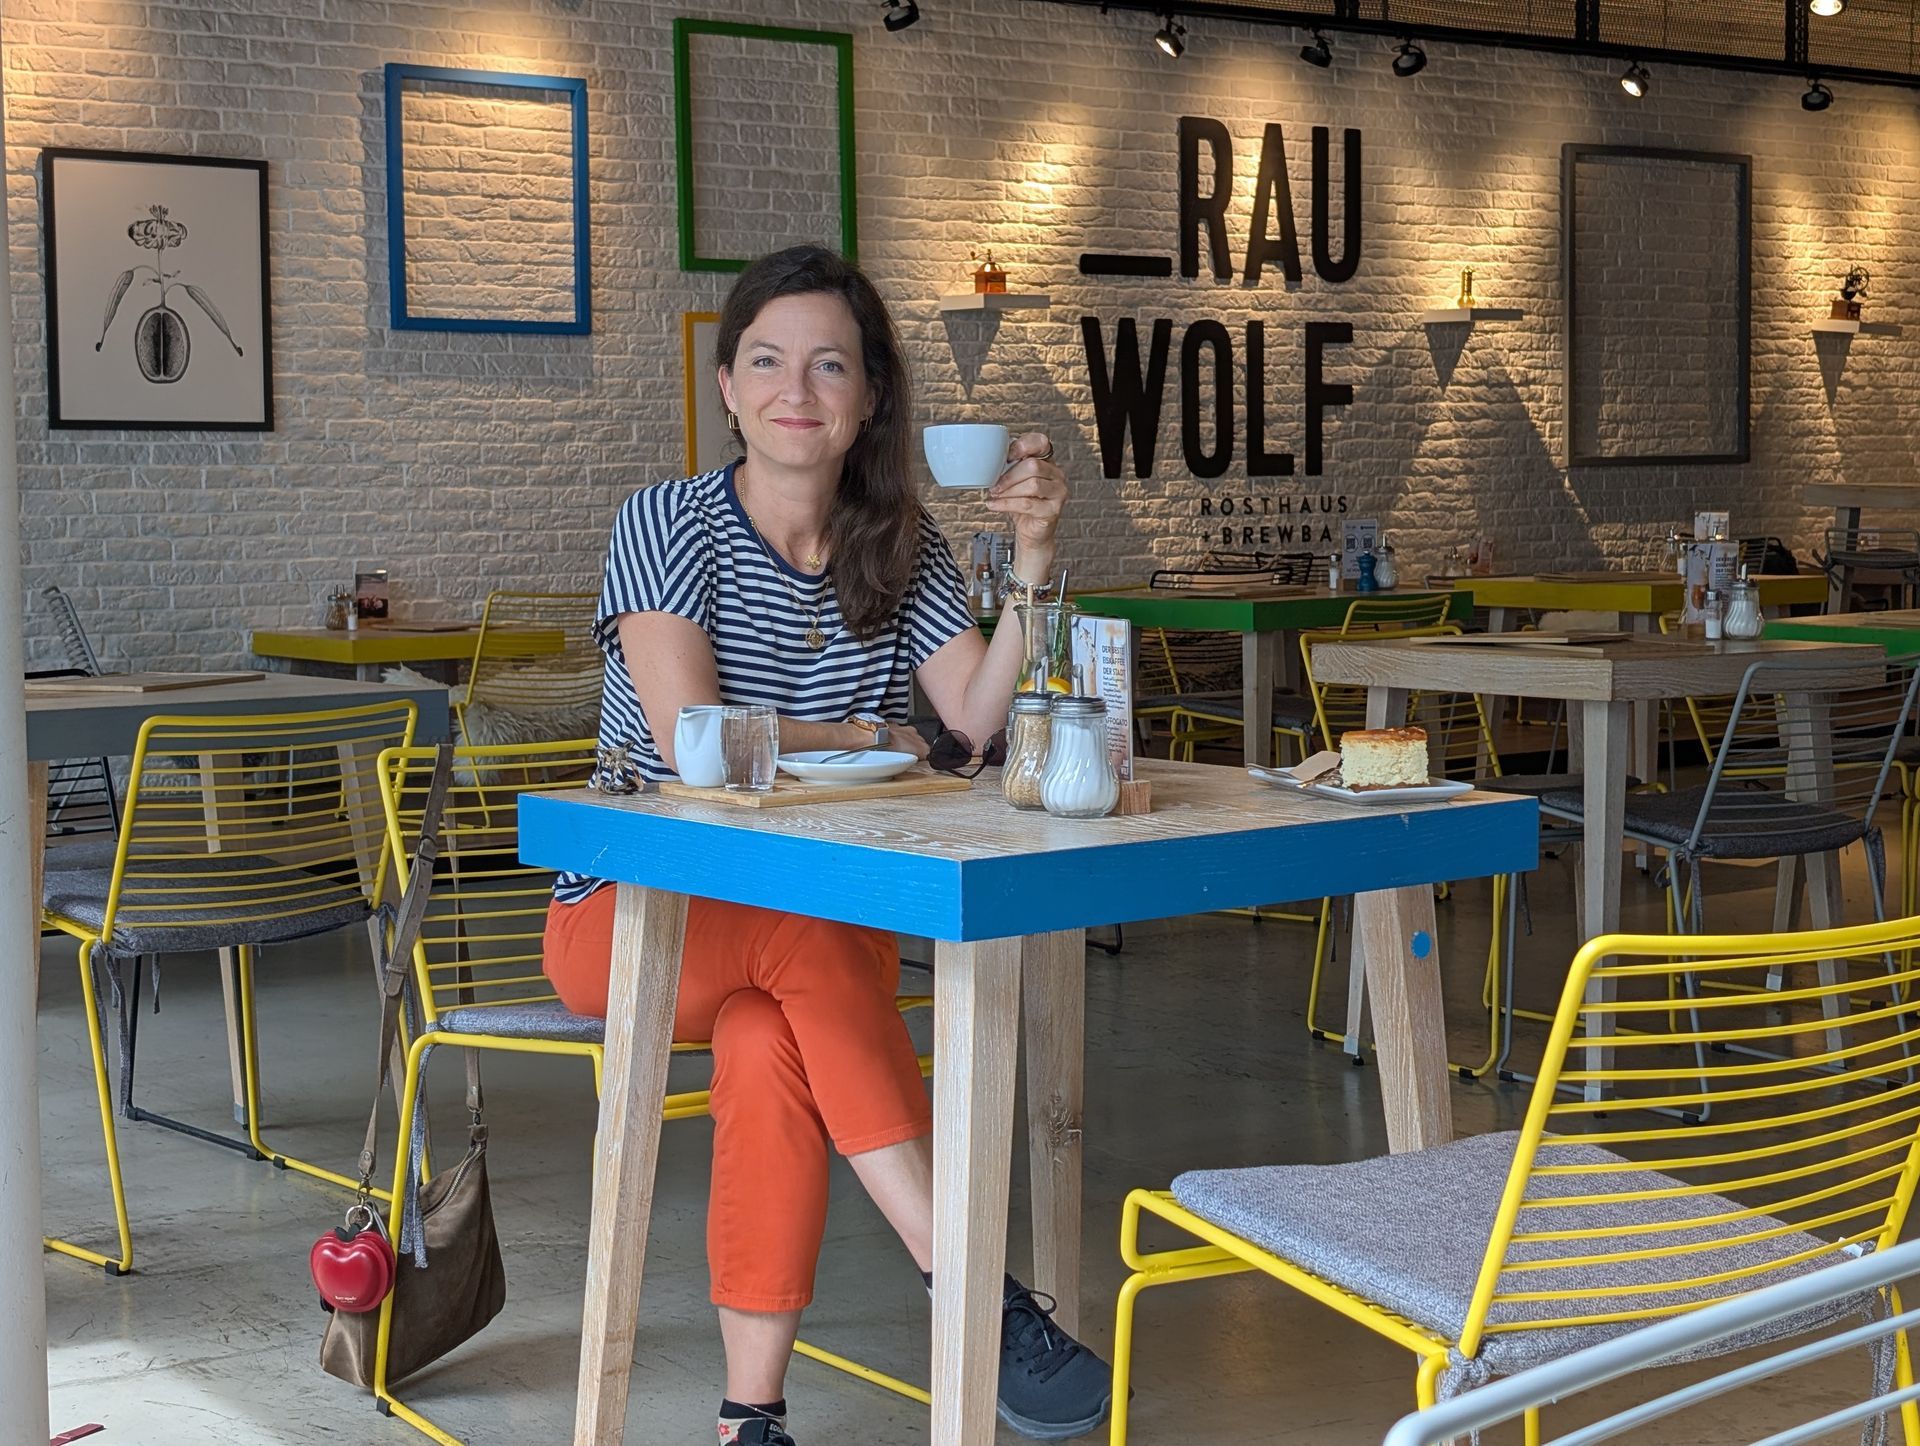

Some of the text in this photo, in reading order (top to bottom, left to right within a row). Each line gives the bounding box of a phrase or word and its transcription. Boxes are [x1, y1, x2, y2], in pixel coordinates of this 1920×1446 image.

[1080, 316, 1354, 479] WOLF
[1200, 492, 1348, 516] RÖSTHAUS
[1222, 524, 1333, 545] BREWBA
